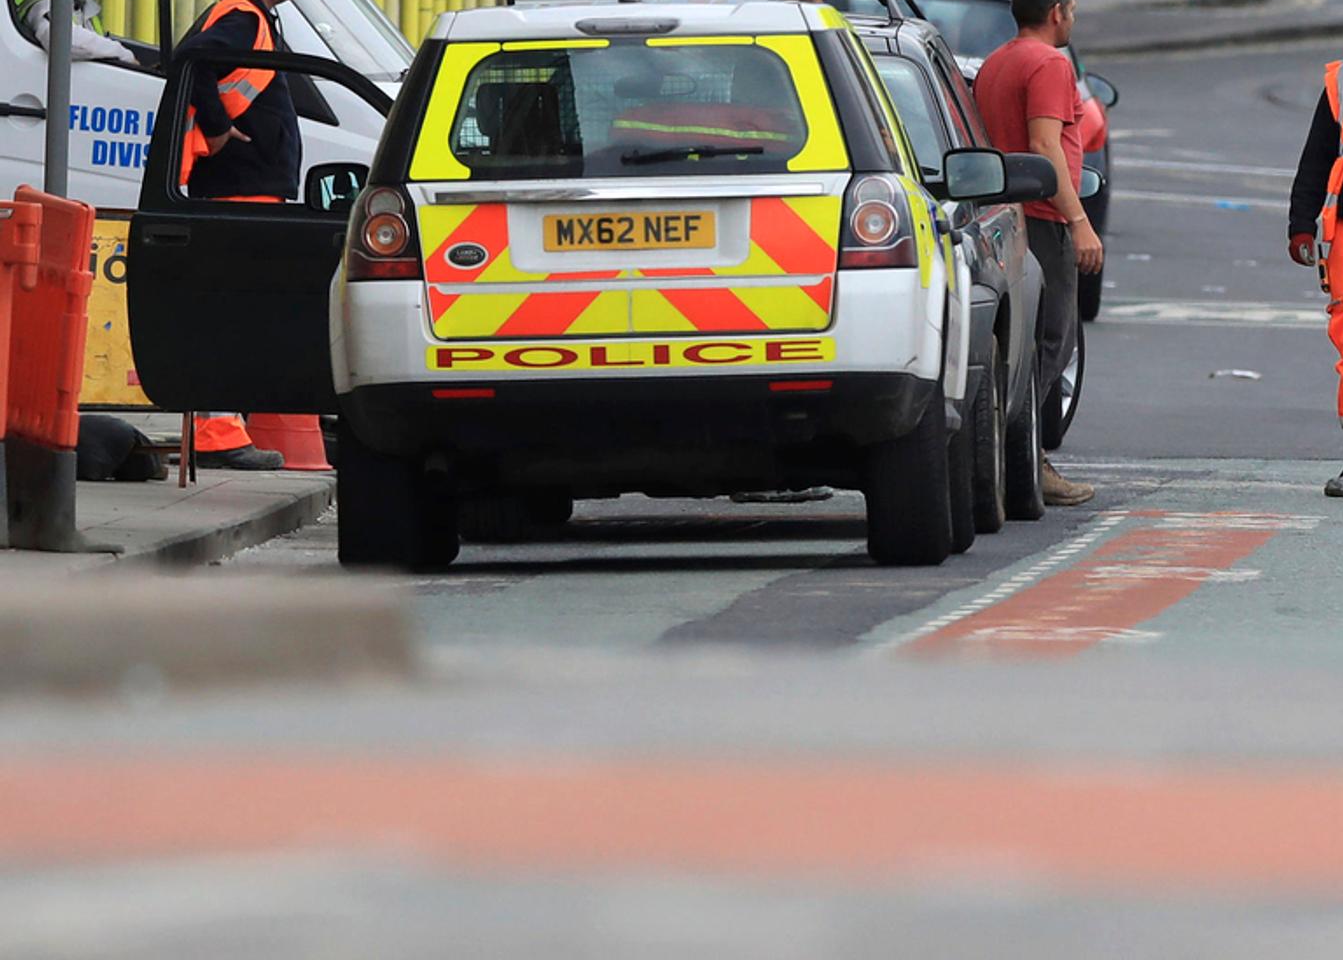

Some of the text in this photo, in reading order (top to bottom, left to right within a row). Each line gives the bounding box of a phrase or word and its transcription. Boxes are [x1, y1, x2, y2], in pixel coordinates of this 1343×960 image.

[68, 105, 140, 136] FLOOR
[556, 214, 702, 246] MX62 NEF
[435, 340, 824, 369] POLICE
